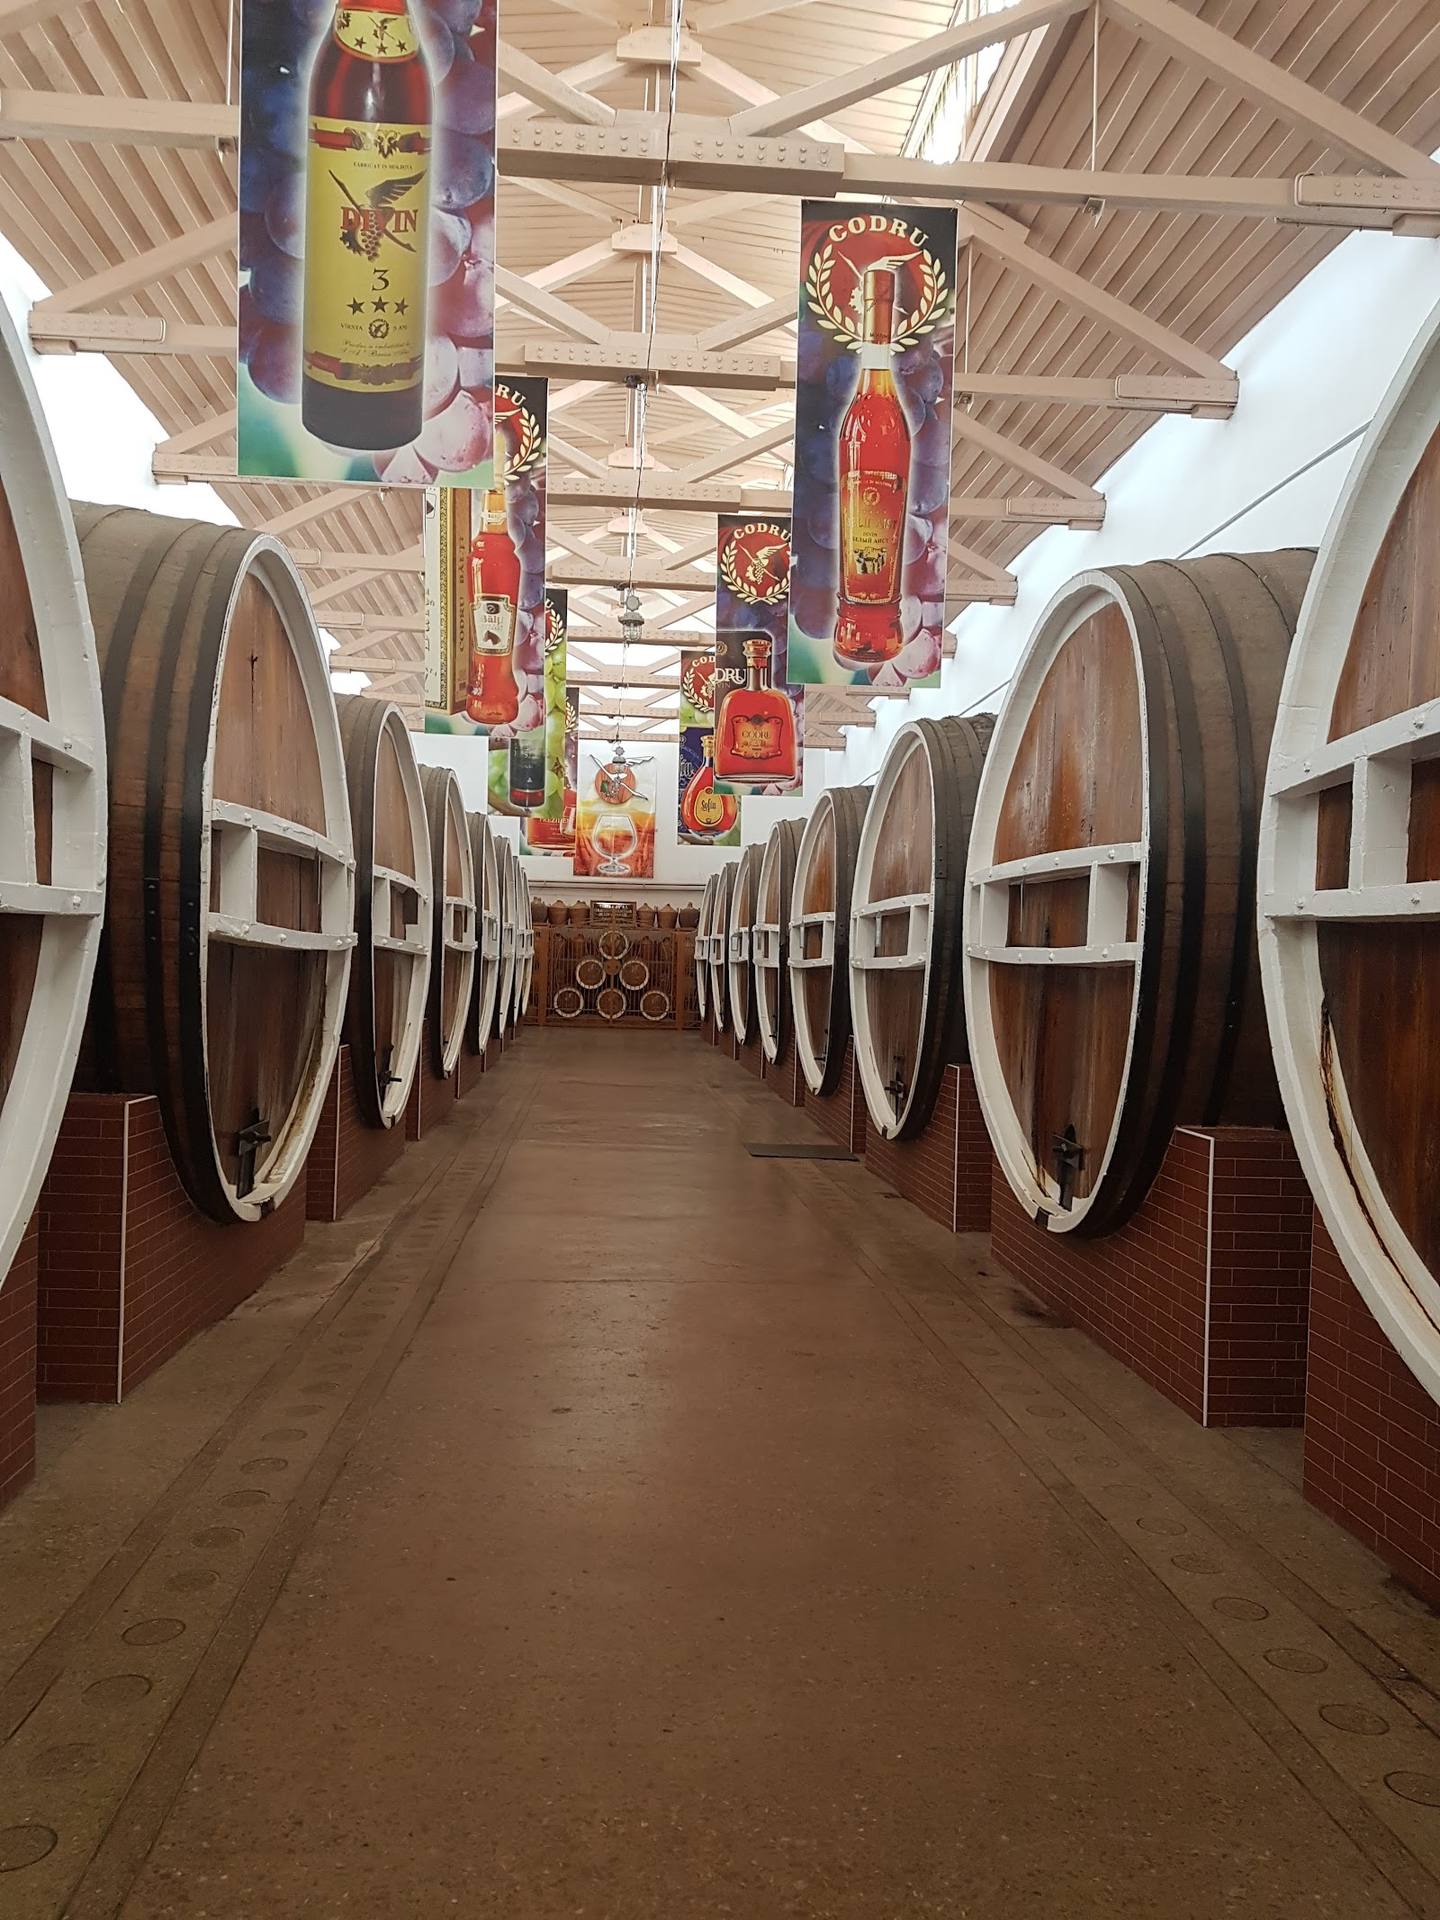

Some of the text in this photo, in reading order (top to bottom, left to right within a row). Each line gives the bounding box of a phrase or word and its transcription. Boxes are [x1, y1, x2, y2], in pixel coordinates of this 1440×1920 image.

[829, 215, 929, 247] CODRU
[371, 268, 390, 291] 3
[734, 522, 791, 541] CODRU
[692, 655, 715, 667] COD
[715, 667, 747, 685] DRU
